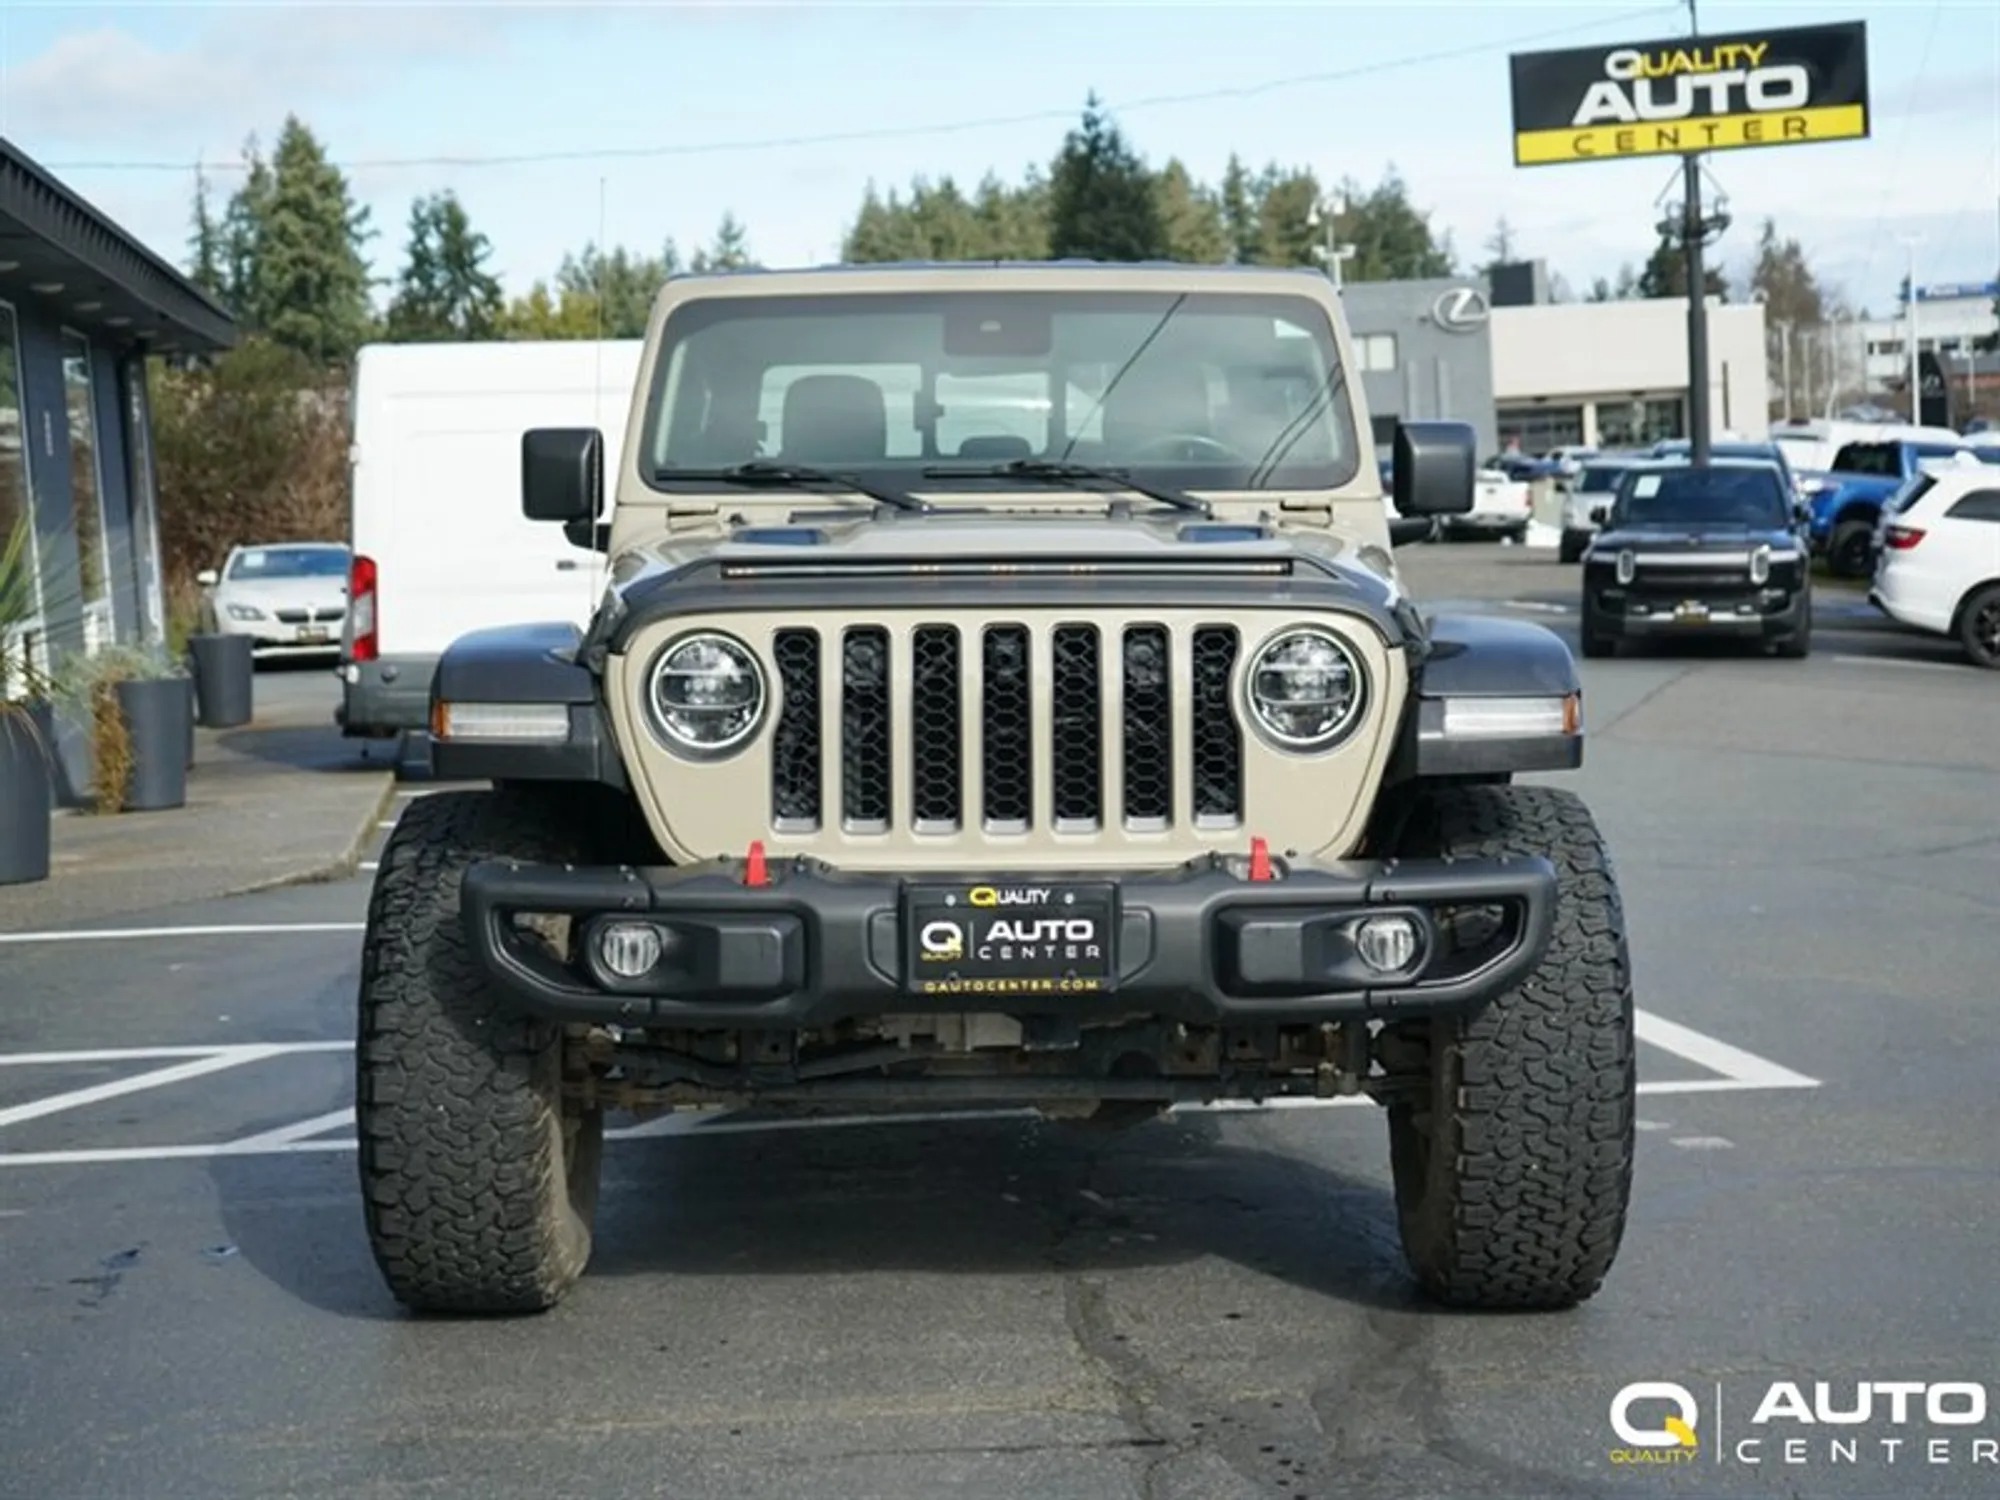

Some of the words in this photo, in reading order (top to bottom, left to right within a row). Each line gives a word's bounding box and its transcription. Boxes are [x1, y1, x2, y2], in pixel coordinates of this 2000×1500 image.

[1605, 43, 1767, 78] QUALITY
[1572, 65, 1808, 125] AUTO
[1573, 117, 1807, 155] CENTER
[987, 920, 1093, 941] AUTO
[978, 945, 1100, 959] CENTER
